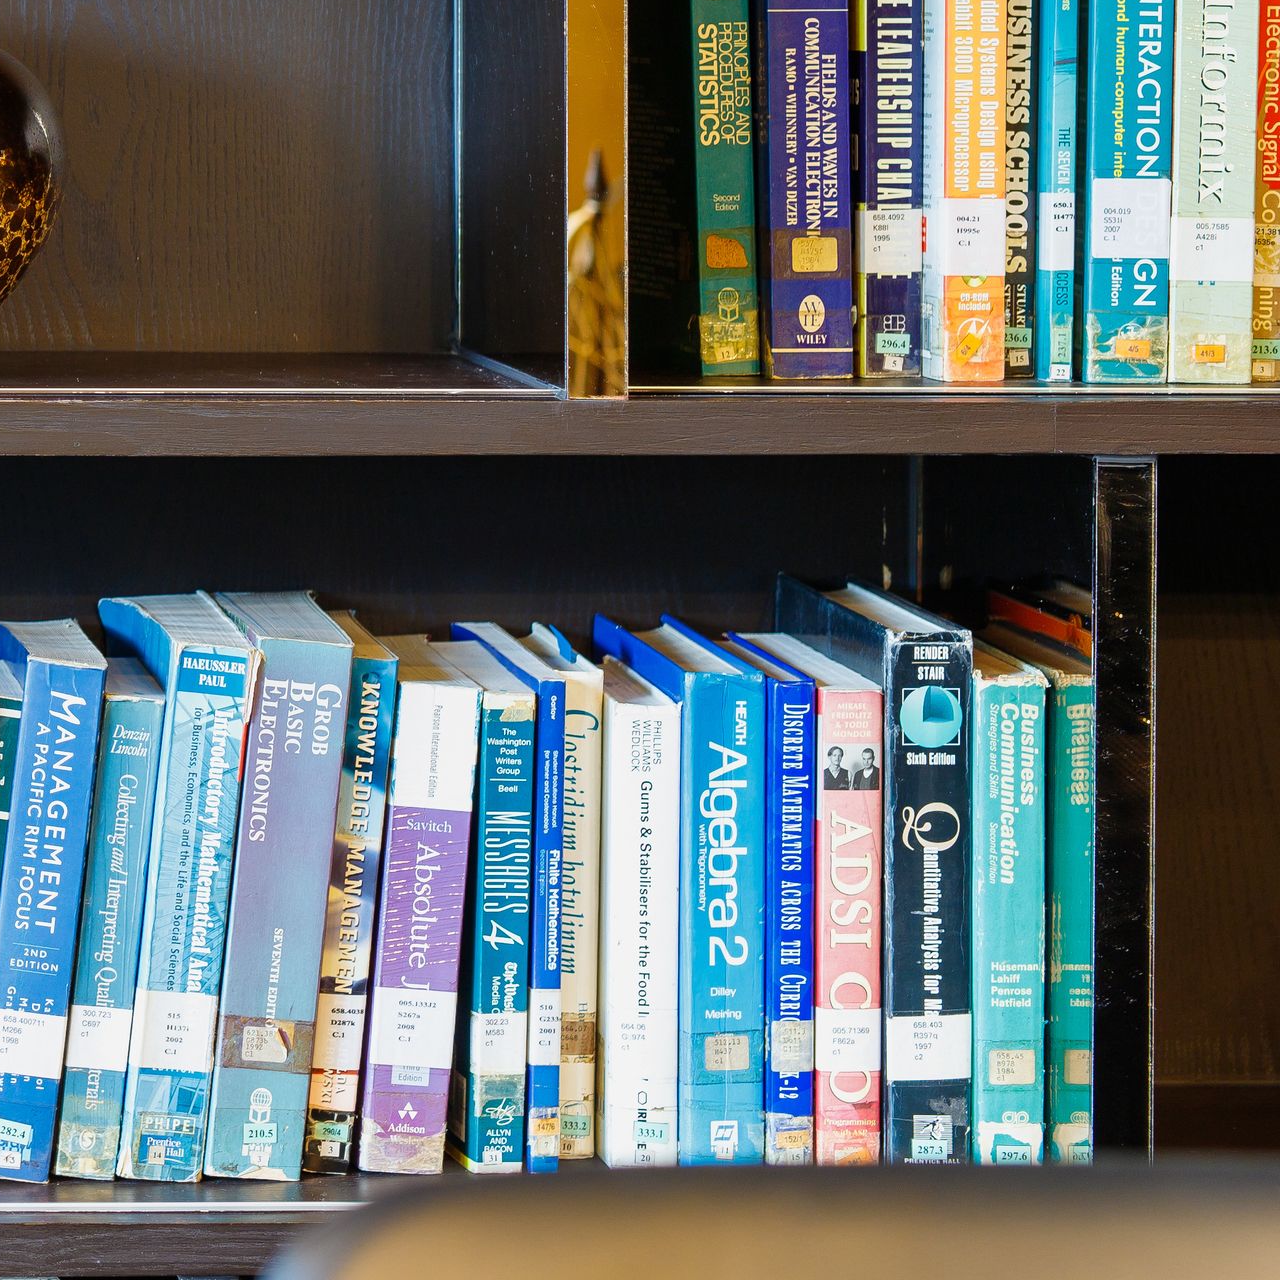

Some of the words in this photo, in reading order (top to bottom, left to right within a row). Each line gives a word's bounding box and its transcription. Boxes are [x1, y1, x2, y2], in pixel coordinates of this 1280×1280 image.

[698, 24, 719, 146] STATISTICS
[877, 20, 912, 148] LEADERSHIP
[953, 37, 972, 74] 3000
[951, 80, 973, 192] Microprocessor
[1005, 130, 1030, 273] SCHOOLS
[735, 701, 747, 746] HEATH
[1018, 703, 1039, 805] Business
[26, 742, 48, 818] PACIFIC
[197, 708, 234, 827] Introductory
[637, 781, 652, 822] Gums
[996, 703, 1019, 885] Communication
[21, 825, 40, 860] RIM
[482, 811, 530, 913] MESSAGES
[548, 849, 560, 885] Finite
[639, 827, 651, 837] &
[699, 741, 748, 929] Algebra
[14, 865, 37, 930] FOCUS
[190, 831, 222, 950] Mathematical
[409, 842, 440, 968] Absolute
[637, 843, 652, 916] Stabilisers
[829, 812, 872, 950] ADSI
[482, 921, 523, 950] 4
[545, 888, 560, 970] Mathematics
[638, 921, 652, 939] for
[638, 945, 651, 967] the
[710, 935, 747, 967] 2
[637, 972, 651, 1005] Food
